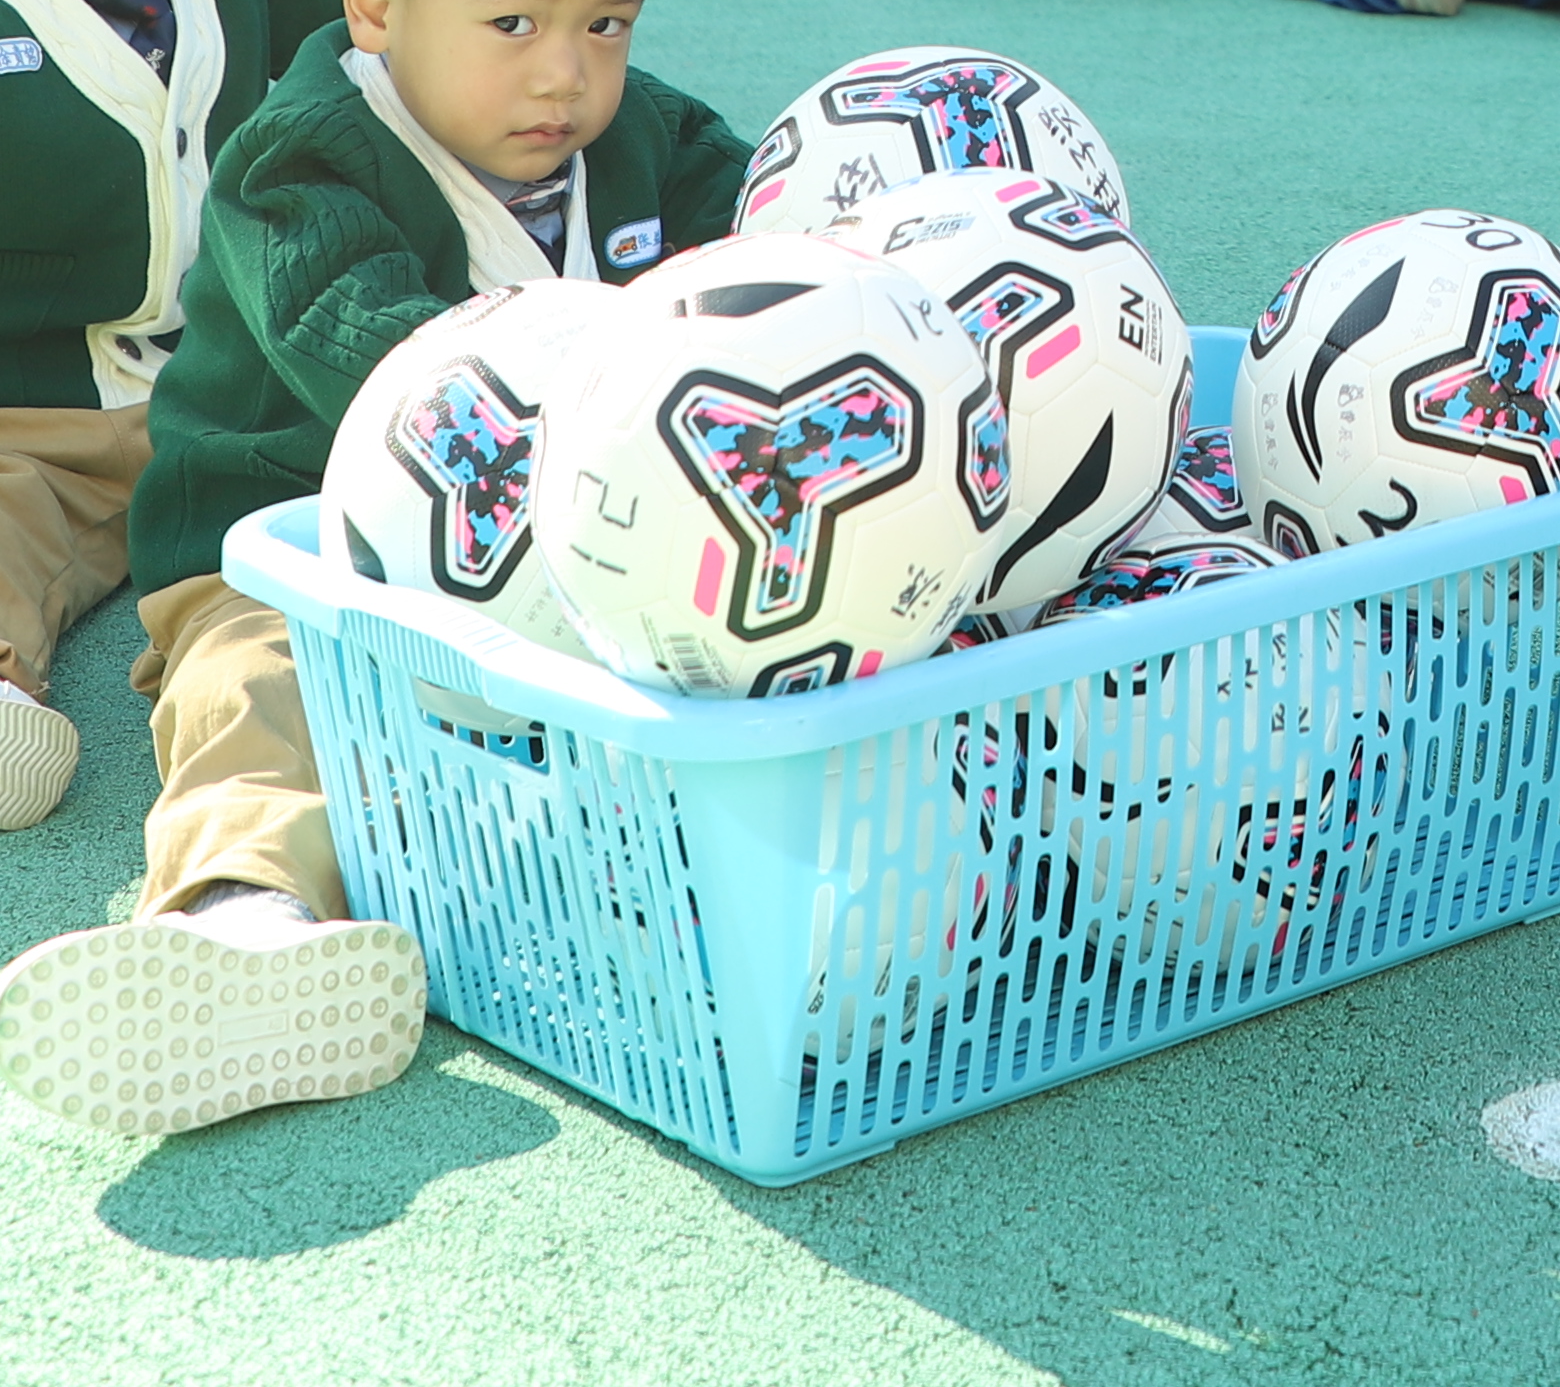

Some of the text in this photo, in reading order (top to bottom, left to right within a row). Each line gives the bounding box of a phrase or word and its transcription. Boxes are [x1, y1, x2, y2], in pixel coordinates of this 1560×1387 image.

[882, 216, 926, 255] 3
[1420, 213, 1524, 252] 30
[1119, 284, 1144, 351] EN
